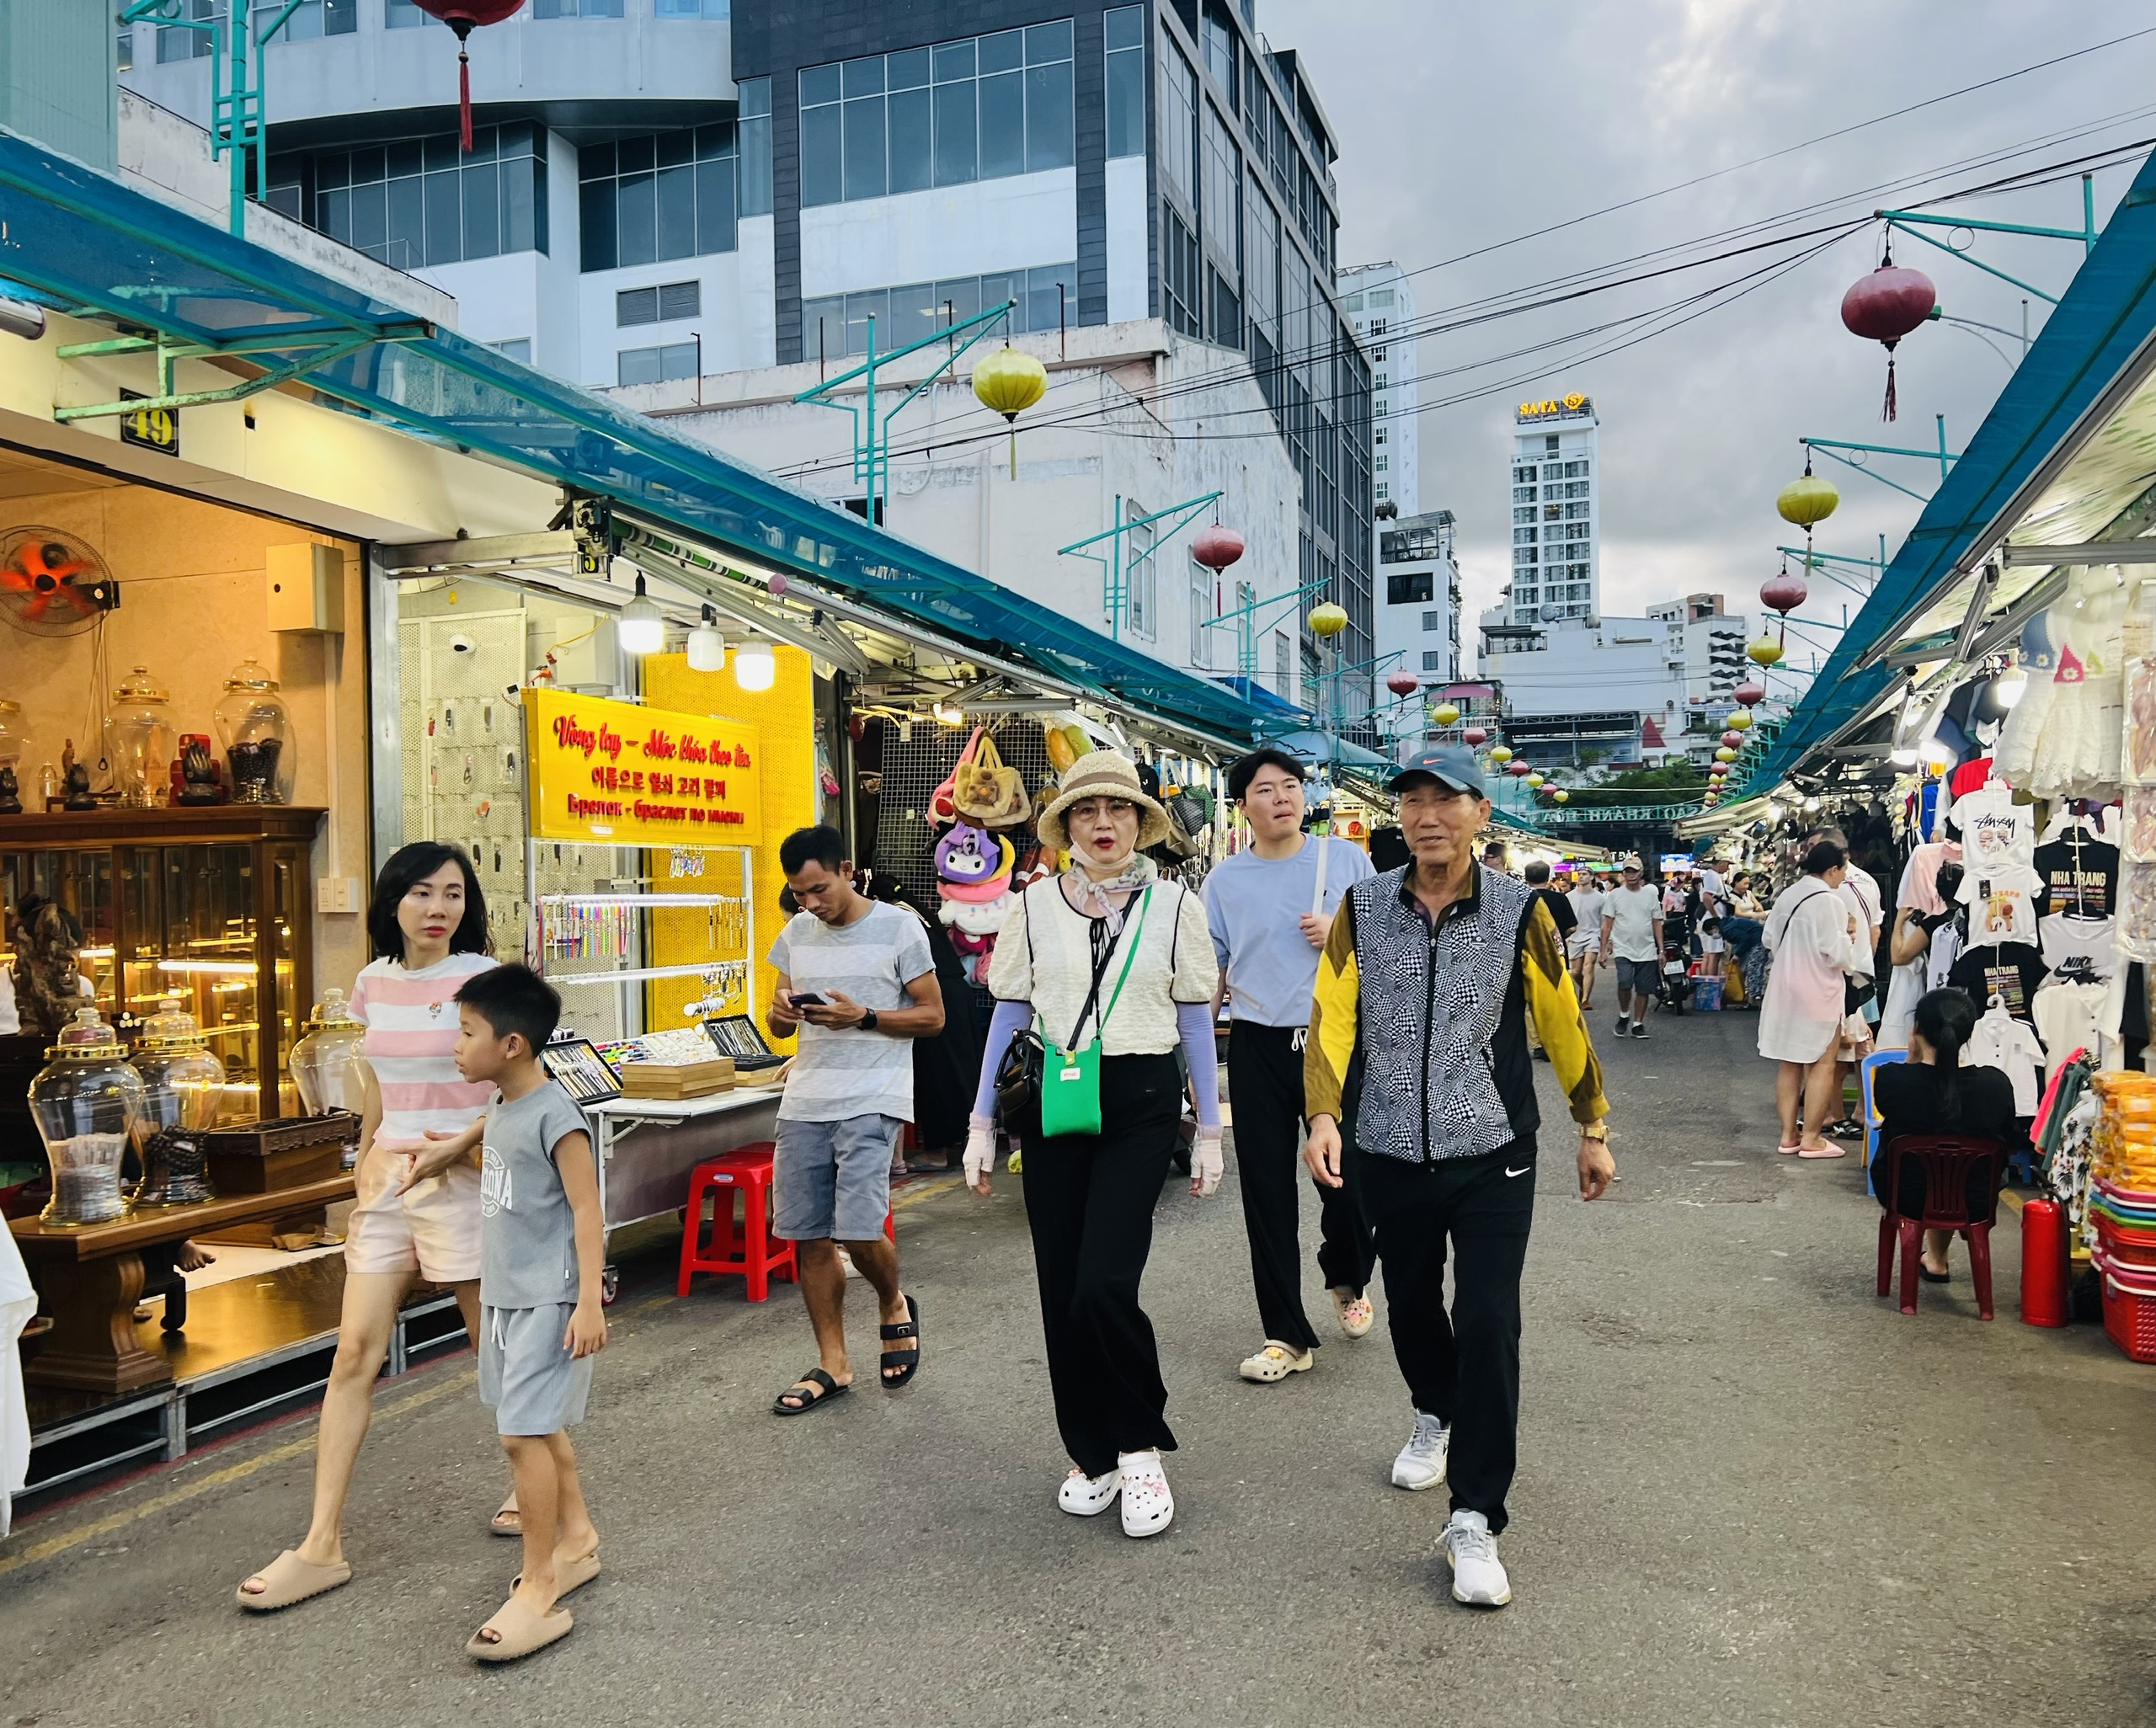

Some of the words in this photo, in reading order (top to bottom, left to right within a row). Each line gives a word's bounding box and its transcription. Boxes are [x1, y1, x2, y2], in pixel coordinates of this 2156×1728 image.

[1520, 400, 1557, 414] SATA
[127, 410, 173, 445] 49
[600, 723, 622, 760] tay
[643, 729, 677, 758] Móc
[709, 740, 733, 765] theo
[591, 766, 645, 790] 이름으로
[648, 772, 673, 794] 열쇠
[677, 776, 700, 797] 고리
[568, 793, 622, 818] Брелок
[634, 799, 687, 822] браслет
[689, 808, 706, 821] по
[707, 809, 744, 824] имени
[2051, 871, 2070, 885] NHA
[2073, 872, 2106, 887] TRANG
[1984, 968, 1997, 977] NHA
[1997, 965, 2019, 975] TRANG
[481, 1168, 512, 1210] ZONA
